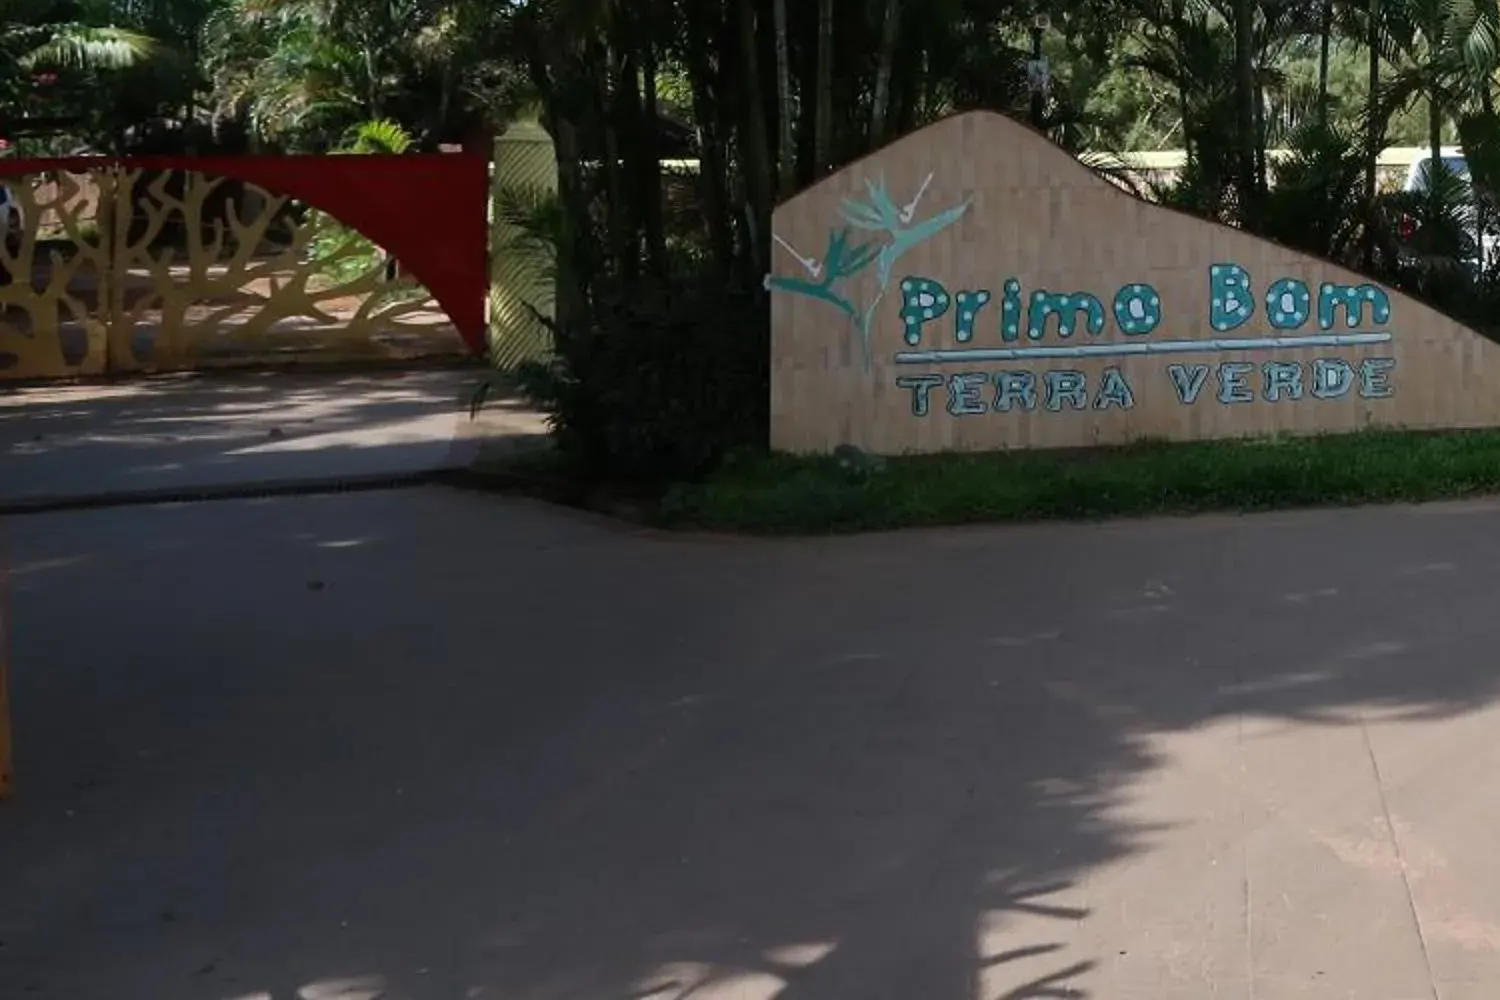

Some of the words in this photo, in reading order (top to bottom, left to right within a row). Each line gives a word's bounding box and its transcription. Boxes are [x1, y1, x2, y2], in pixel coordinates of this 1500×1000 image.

[900, 276, 1161, 346] Primo
[1209, 263, 1391, 331] Bom
[896, 365, 1135, 416] TERRA
[1167, 357, 1396, 404] VERDE
